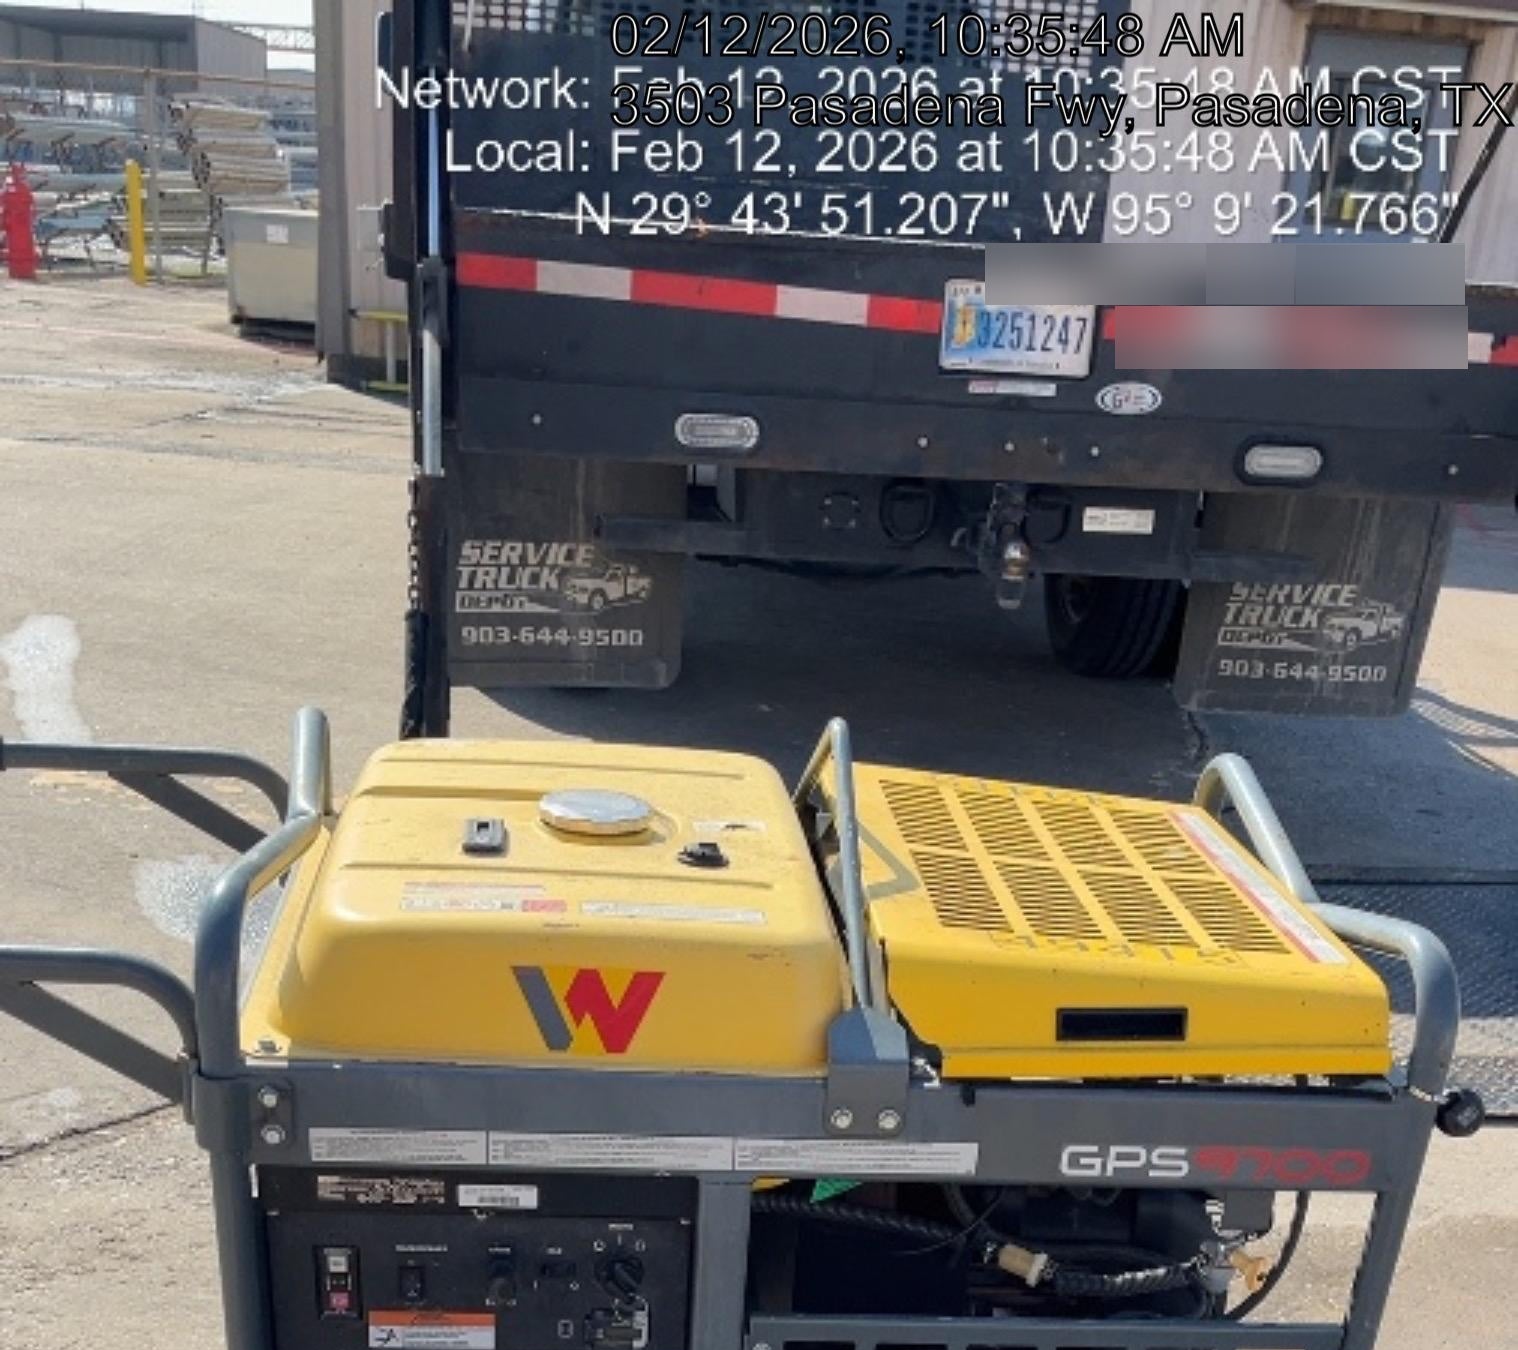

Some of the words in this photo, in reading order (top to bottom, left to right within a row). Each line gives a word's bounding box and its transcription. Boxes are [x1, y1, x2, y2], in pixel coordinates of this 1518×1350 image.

[458, 540, 596, 567] SERVICE
[456, 566, 561, 590] TRUCK
[1229, 582, 1360, 607] SERVICE
[1222, 602, 1321, 628] TRUCK
[461, 626, 644, 647] 903-644-9500
[1218, 658, 1388, 682] 903-644-9500
